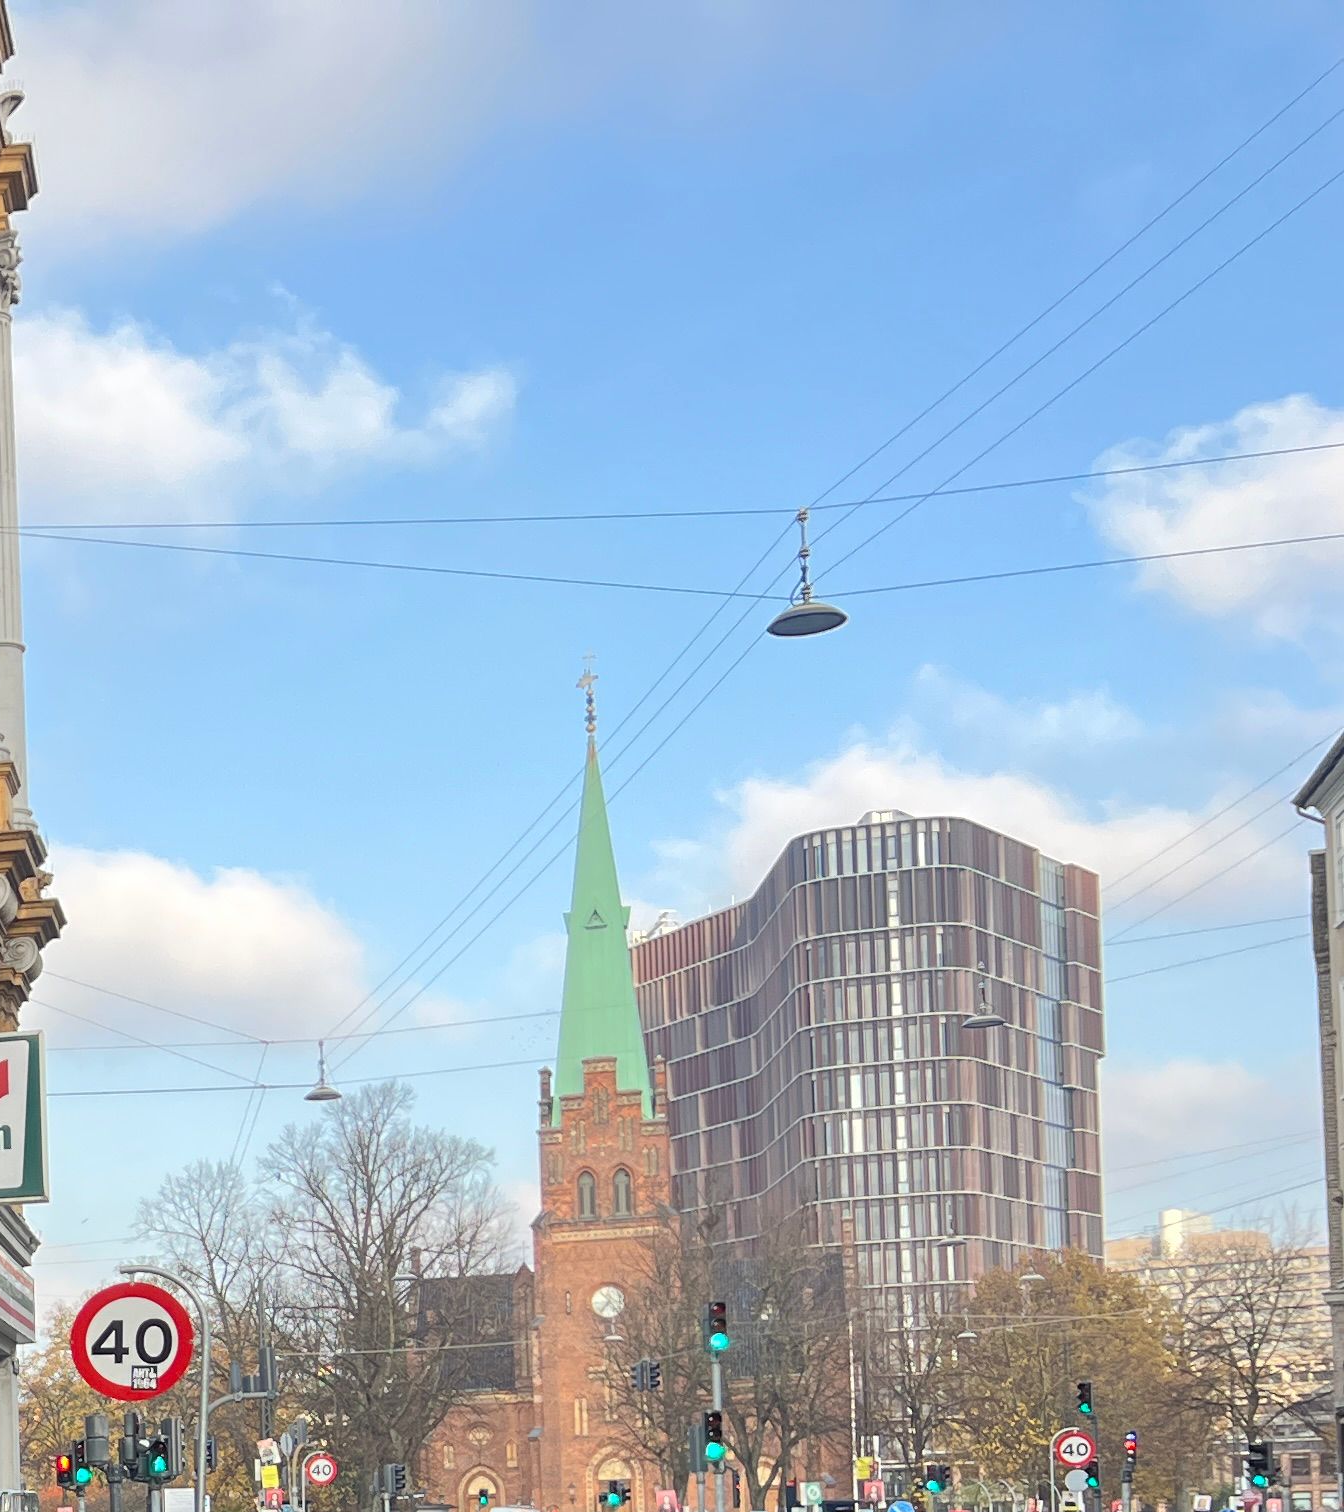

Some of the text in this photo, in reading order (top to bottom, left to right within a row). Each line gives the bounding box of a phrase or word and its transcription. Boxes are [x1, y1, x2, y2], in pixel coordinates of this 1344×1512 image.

[91, 1318, 172, 1364] 40
[1063, 1442, 1088, 1456] 40
[311, 1464, 332, 1476] 40
